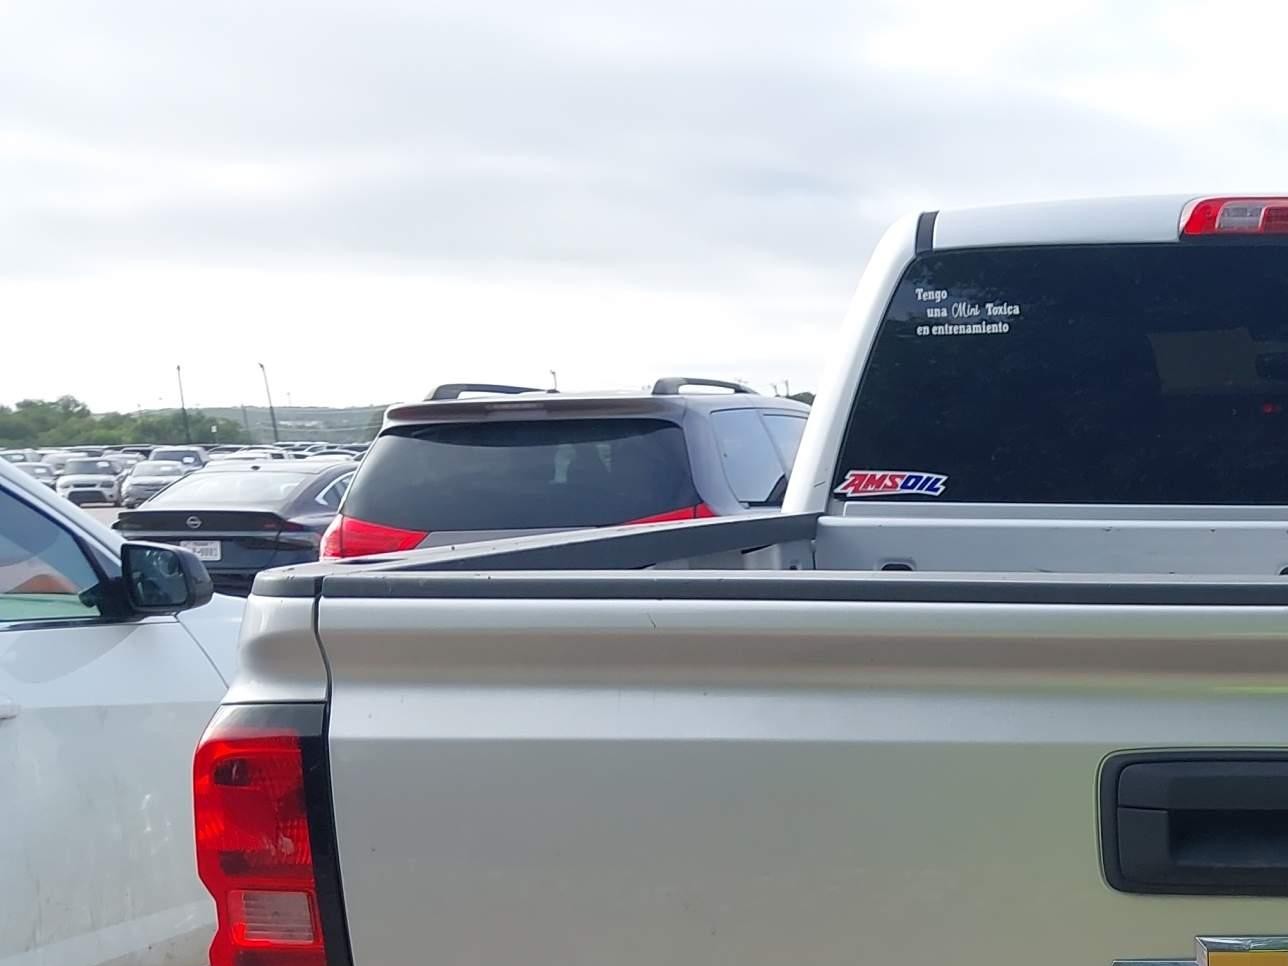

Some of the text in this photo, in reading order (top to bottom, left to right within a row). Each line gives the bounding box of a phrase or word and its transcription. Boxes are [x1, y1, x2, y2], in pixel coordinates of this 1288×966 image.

[915, 288, 948, 303] Tengo
[926, 302, 1020, 318] una Mini Toxica
[916, 321, 1010, 336] en entrenamiento
[837, 471, 946, 495] AMSOIL
